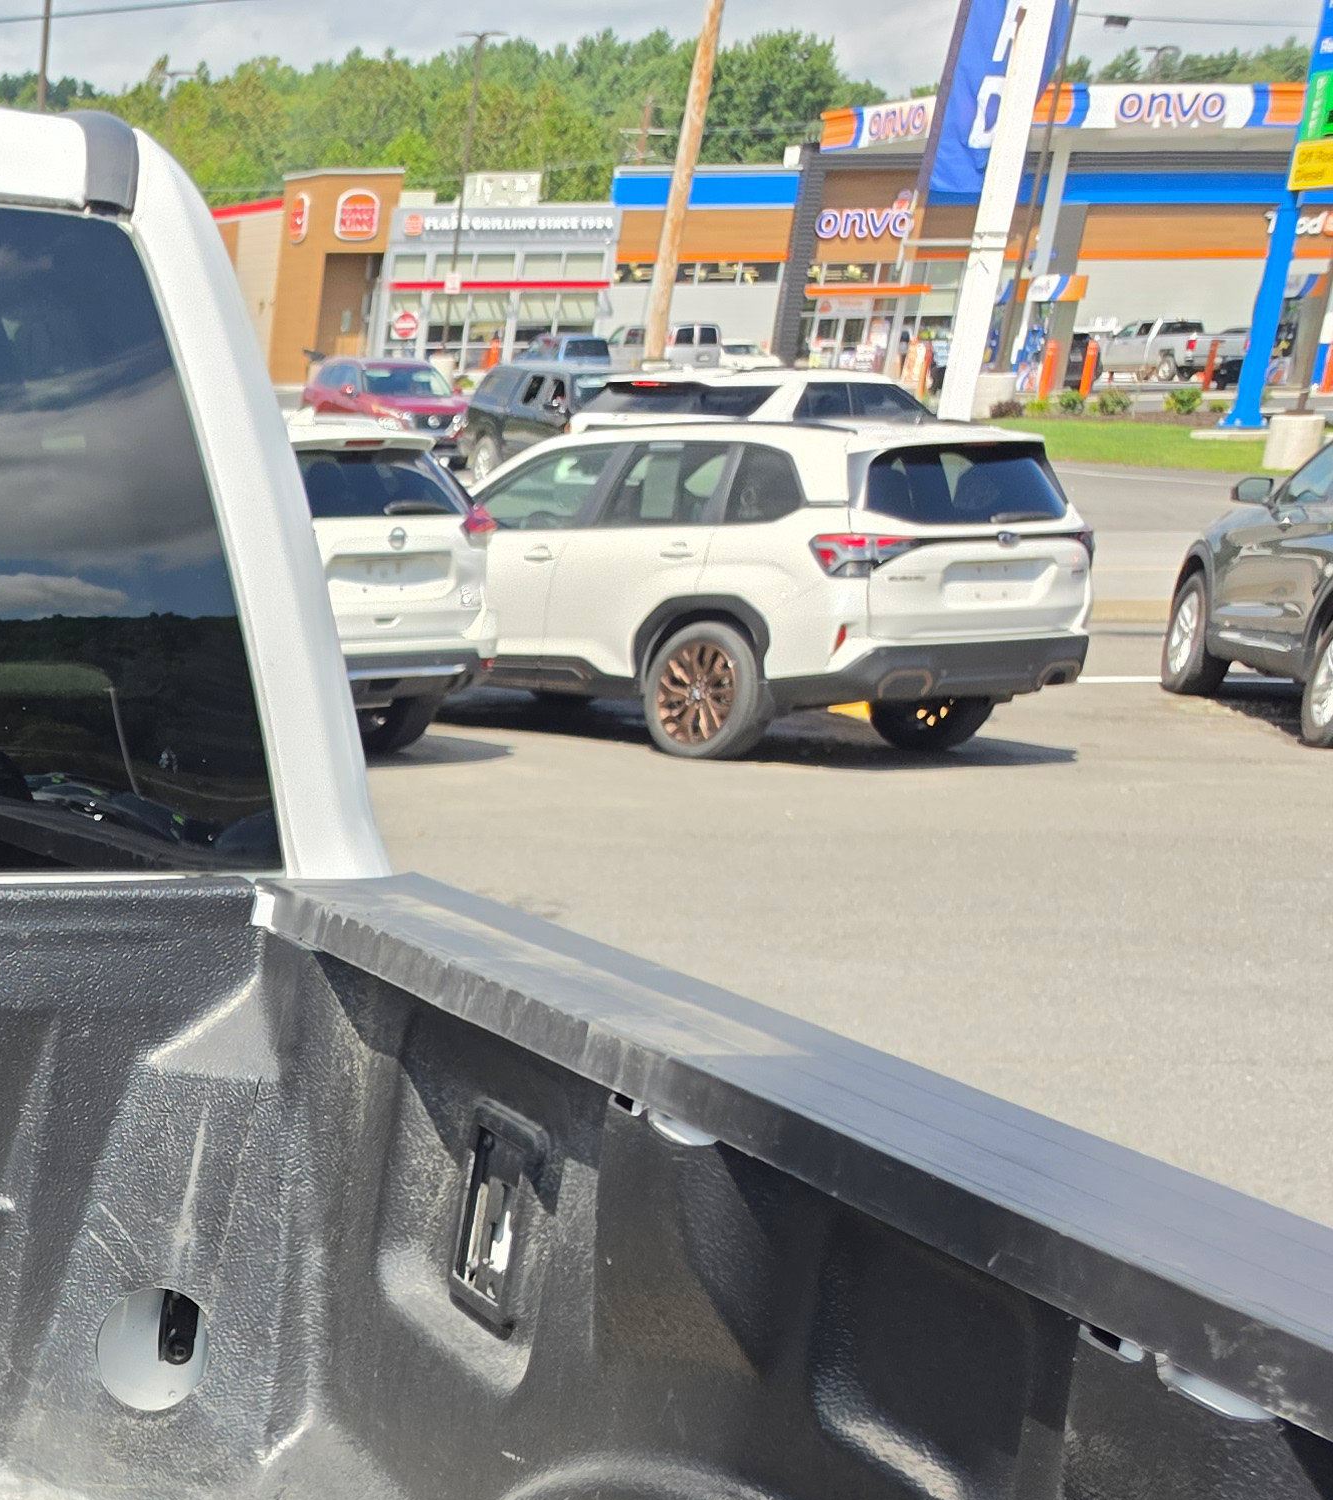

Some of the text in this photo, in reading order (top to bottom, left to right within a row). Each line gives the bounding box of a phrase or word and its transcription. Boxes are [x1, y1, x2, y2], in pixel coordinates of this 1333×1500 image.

[1117, 91, 1226, 121] onvo
[868, 103, 926, 140] onvo
[538, 215, 578, 230] SINCE
[815, 208, 913, 238] onvo
